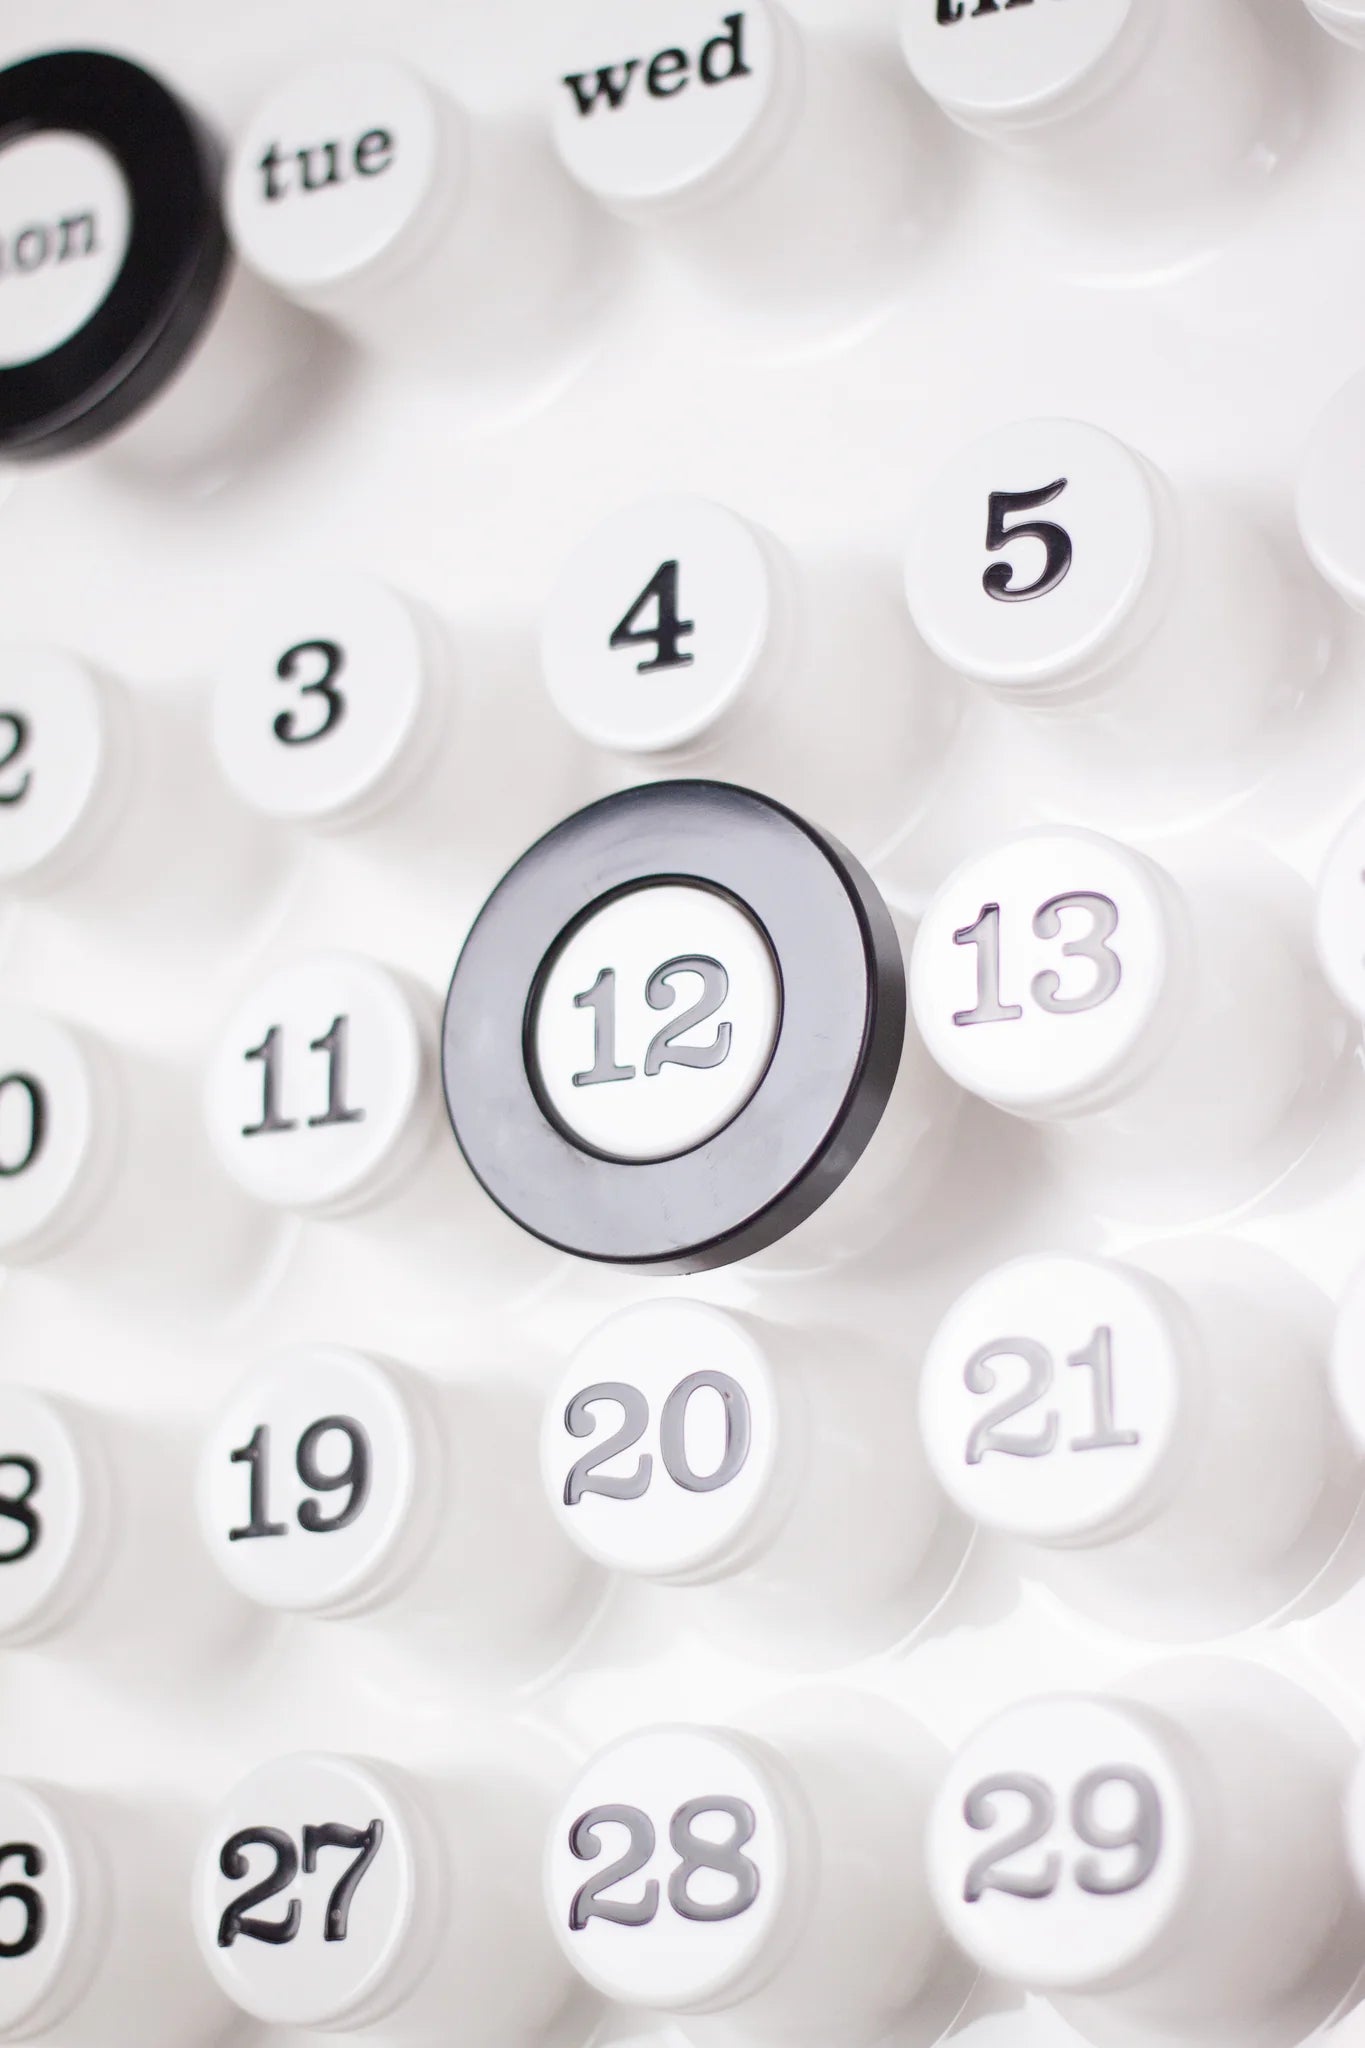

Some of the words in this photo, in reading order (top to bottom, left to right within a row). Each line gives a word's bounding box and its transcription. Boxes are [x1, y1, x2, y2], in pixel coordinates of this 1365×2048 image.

[561, 11, 753, 118] wed
[257, 125, 395, 204] tue
[0, 208, 100, 280] on
[982, 477, 1073, 603] 5
[609, 559, 695, 674] 4
[272, 638, 347, 748] 3
[572, 953, 733, 1088] 12
[952, 890, 1123, 1028] 13
[241, 1014, 366, 1138] 11
[563, 1369, 753, 1506] 20
[963, 1324, 1143, 1466] 21
[228, 1414, 373, 1542] 19
[217, 1818, 385, 1948] 27
[567, 1795, 761, 1931] 28
[962, 1763, 1164, 1904] 29
